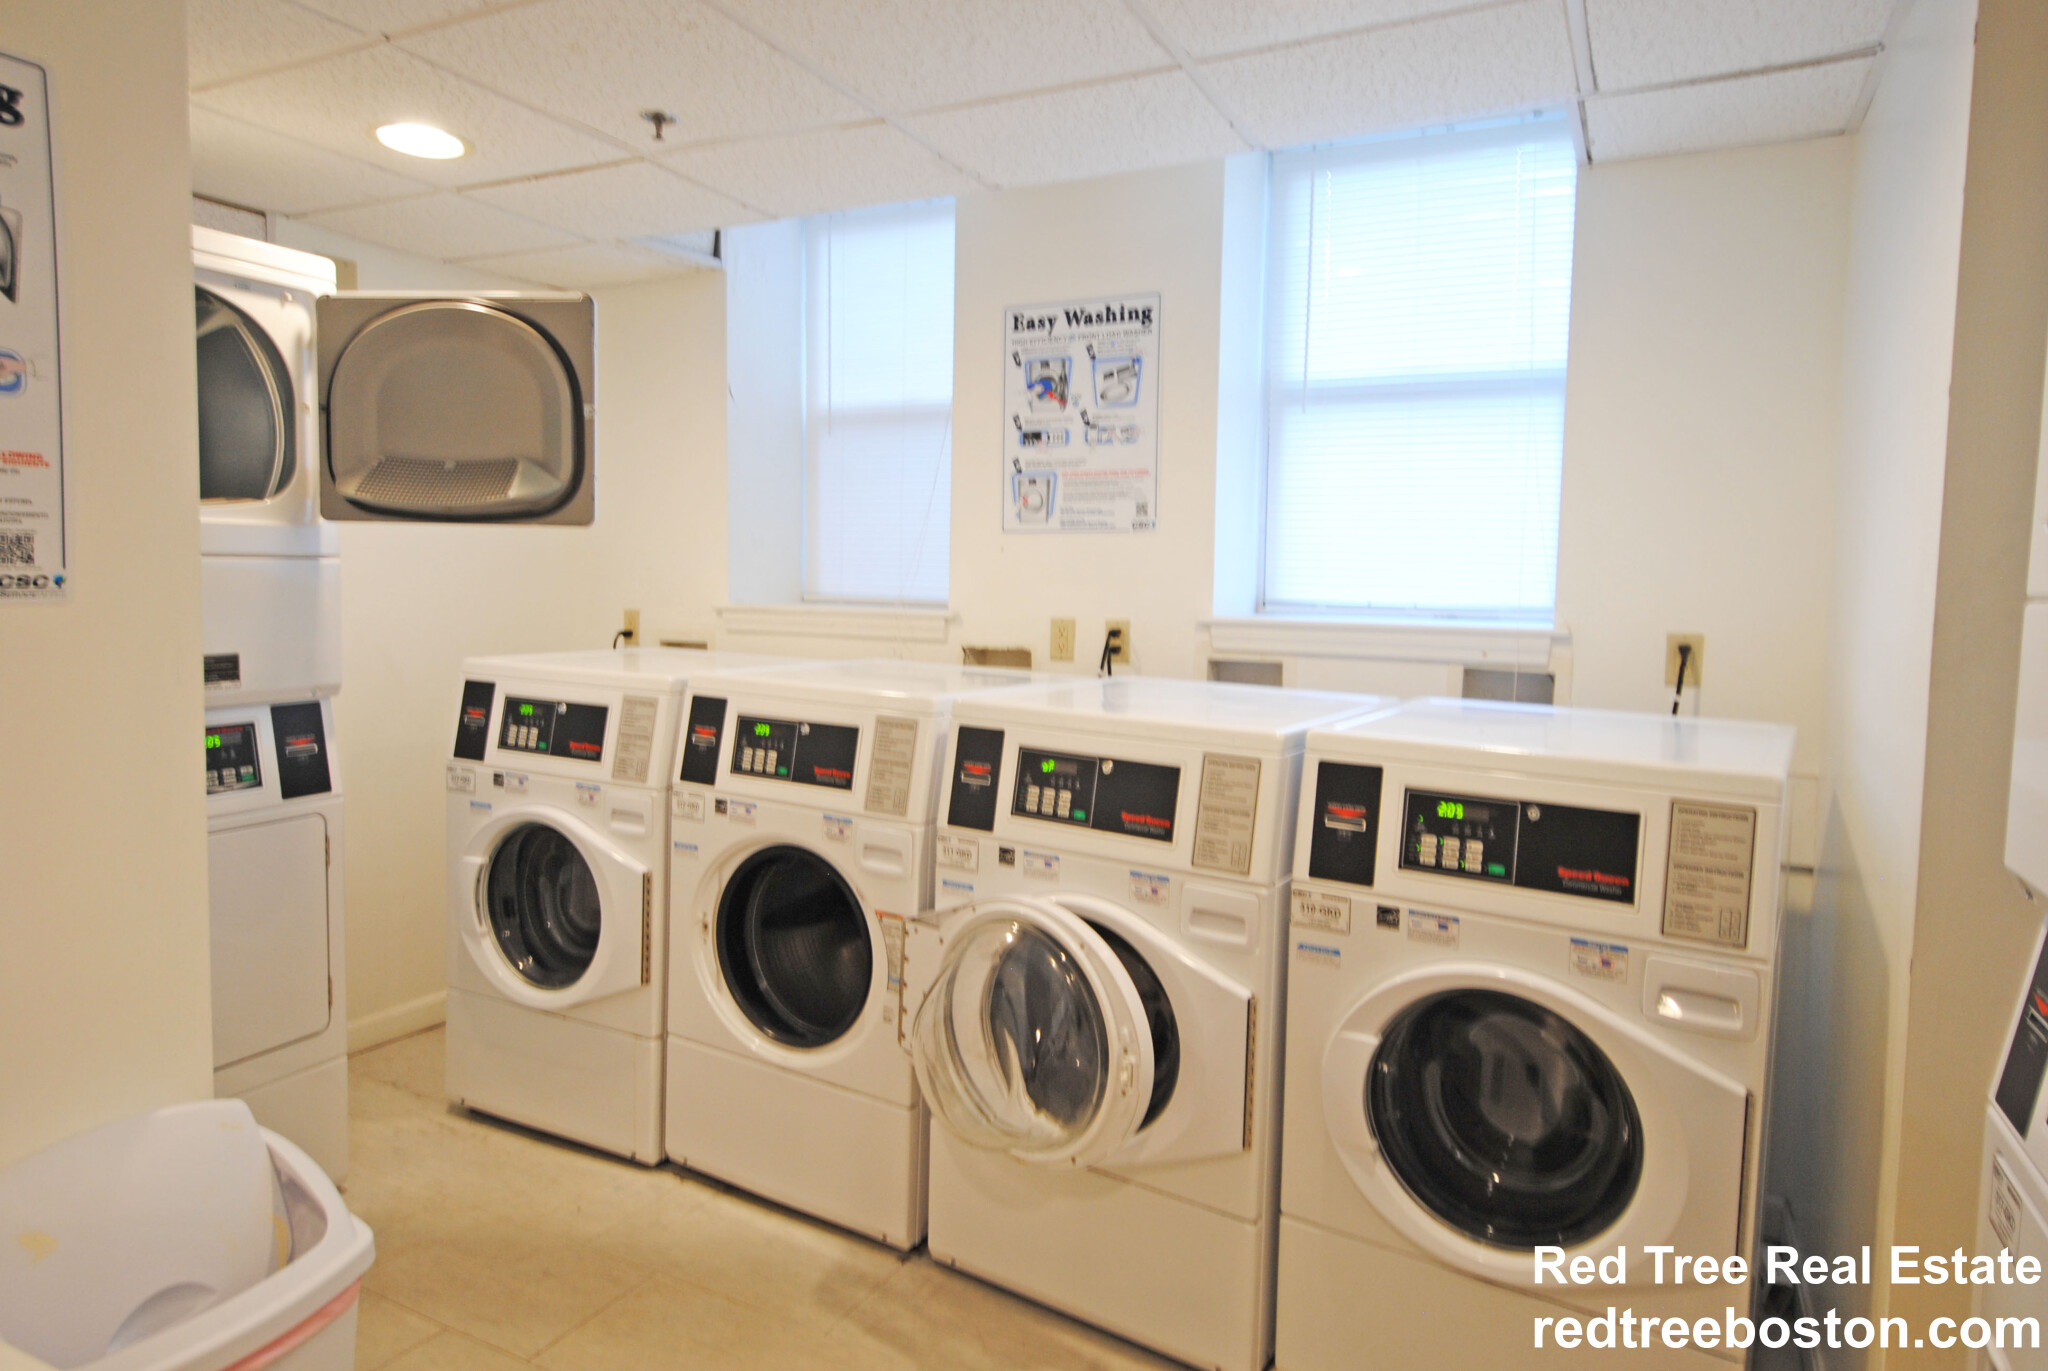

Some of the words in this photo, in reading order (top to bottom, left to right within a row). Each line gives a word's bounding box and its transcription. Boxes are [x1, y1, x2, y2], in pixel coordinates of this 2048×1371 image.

[1013, 313, 1057, 337] Easy
[1064, 302, 1154, 329] Washing
[0, 573, 50, 590] CSC
[1558, 865, 1592, 881] Speed
[1593, 870, 1629, 887] Queen
